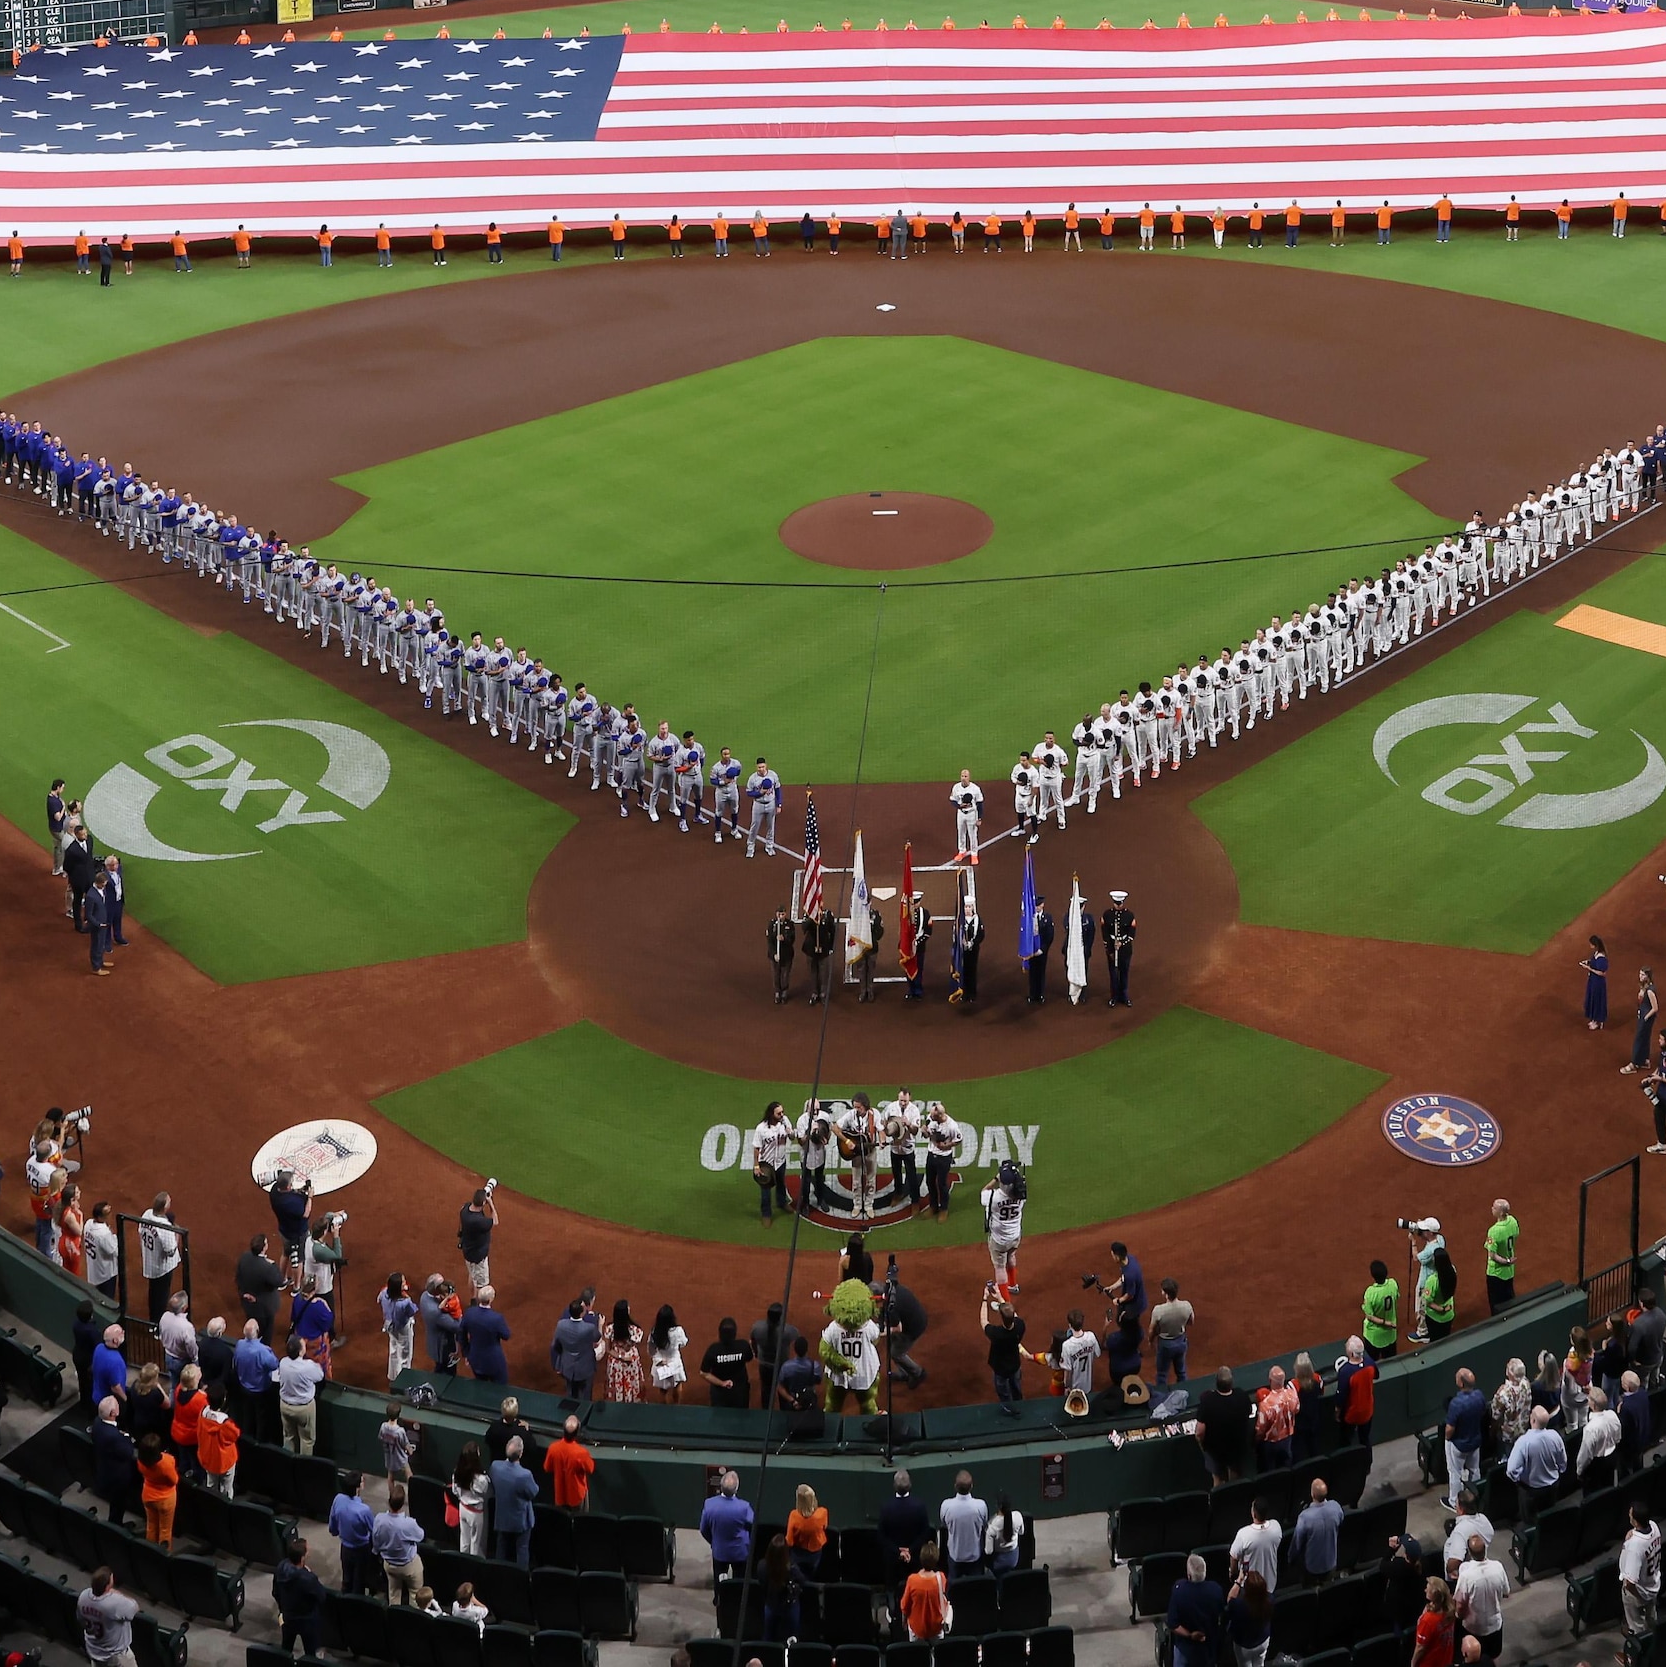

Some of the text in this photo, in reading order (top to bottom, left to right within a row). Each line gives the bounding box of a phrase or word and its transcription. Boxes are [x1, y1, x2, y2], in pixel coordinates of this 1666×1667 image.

[45, 8, 60, 16] CLE
[47, 16, 59, 24] KC
[46, 27, 62, 35] ATH
[47, 36, 61, 44] SEA
[1421, 701, 1599, 816] OXY
[144, 734, 347, 833] OXY
[1389, 1096, 1440, 1139] HOUSTON
[1450, 1122, 1494, 1162] ASTROS
[999, 1207, 1019, 1221] 95
[1078, 1357, 1088, 1373] 7
